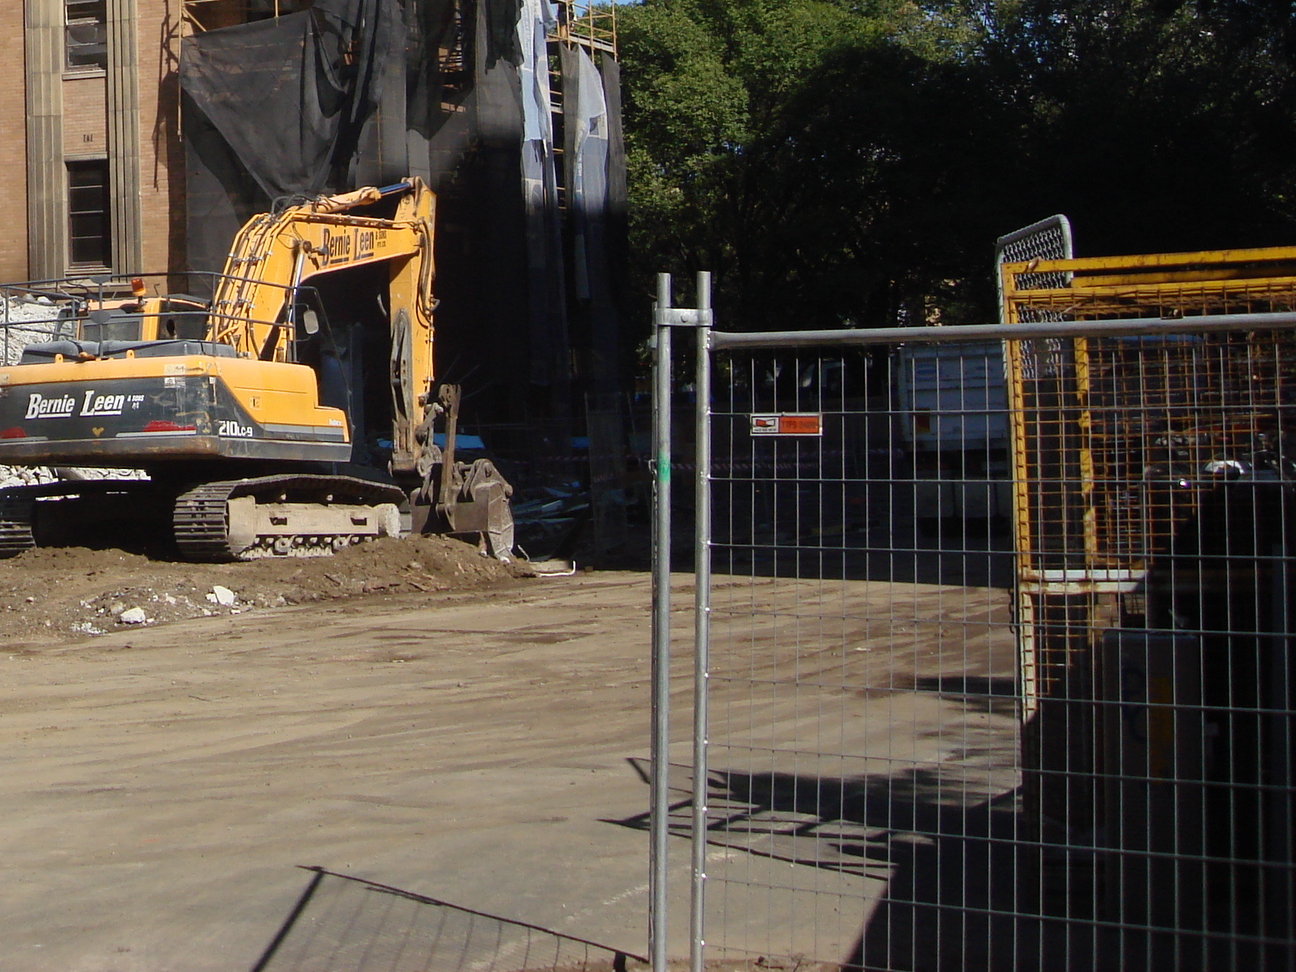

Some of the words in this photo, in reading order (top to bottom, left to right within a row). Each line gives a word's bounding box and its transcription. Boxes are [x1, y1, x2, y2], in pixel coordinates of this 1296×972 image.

[321, 227, 351, 267] Bernie
[353, 228, 375, 261] Leen
[24, 393, 76, 419] Bernie
[79, 390, 125, 417] Leen
